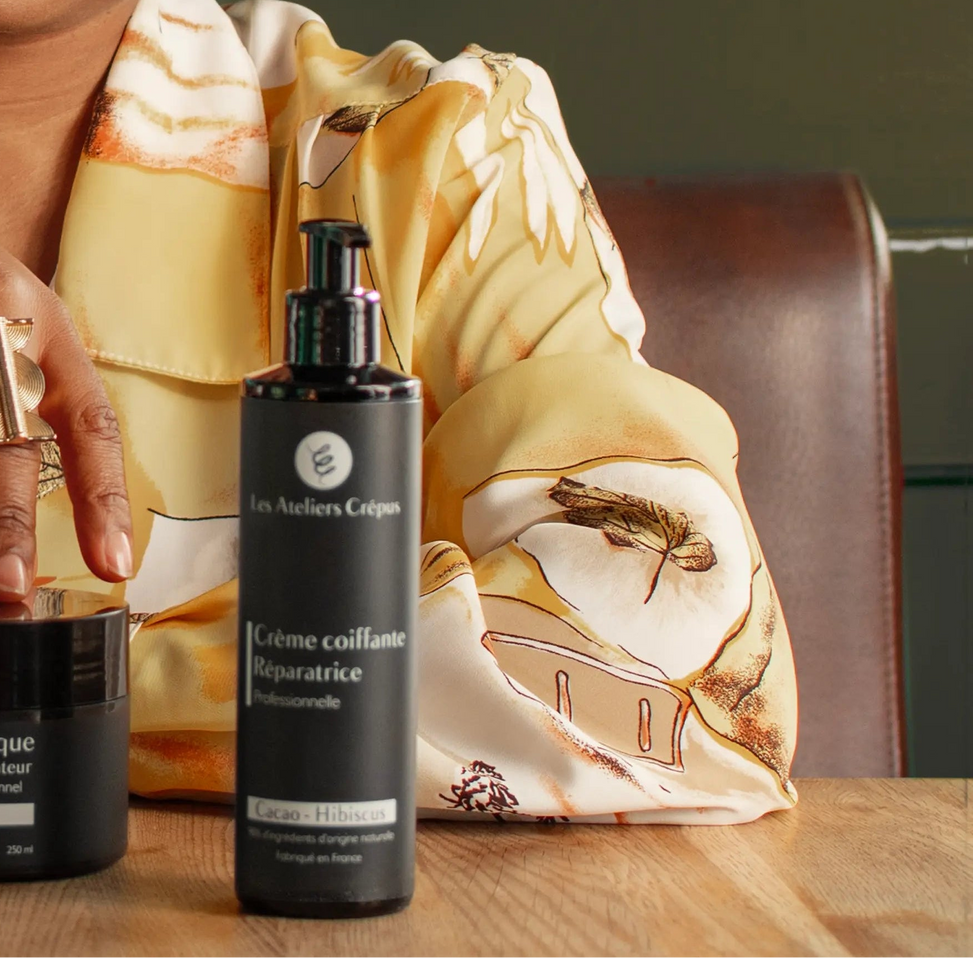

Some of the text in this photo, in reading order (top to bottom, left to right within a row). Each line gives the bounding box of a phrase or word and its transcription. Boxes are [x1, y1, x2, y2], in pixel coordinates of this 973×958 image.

[250, 494, 272, 513] Les
[277, 495, 342, 517] Ateliers
[254, 624, 406, 651] Crème coiffante
[253, 655, 363, 683] Réparatrice
[253, 690, 341, 711] Professionnelle
[255, 800, 301, 821] Cacao
[315, 805, 386, 823] Hibiscus
[7, 844, 34, 855] 250 ml
